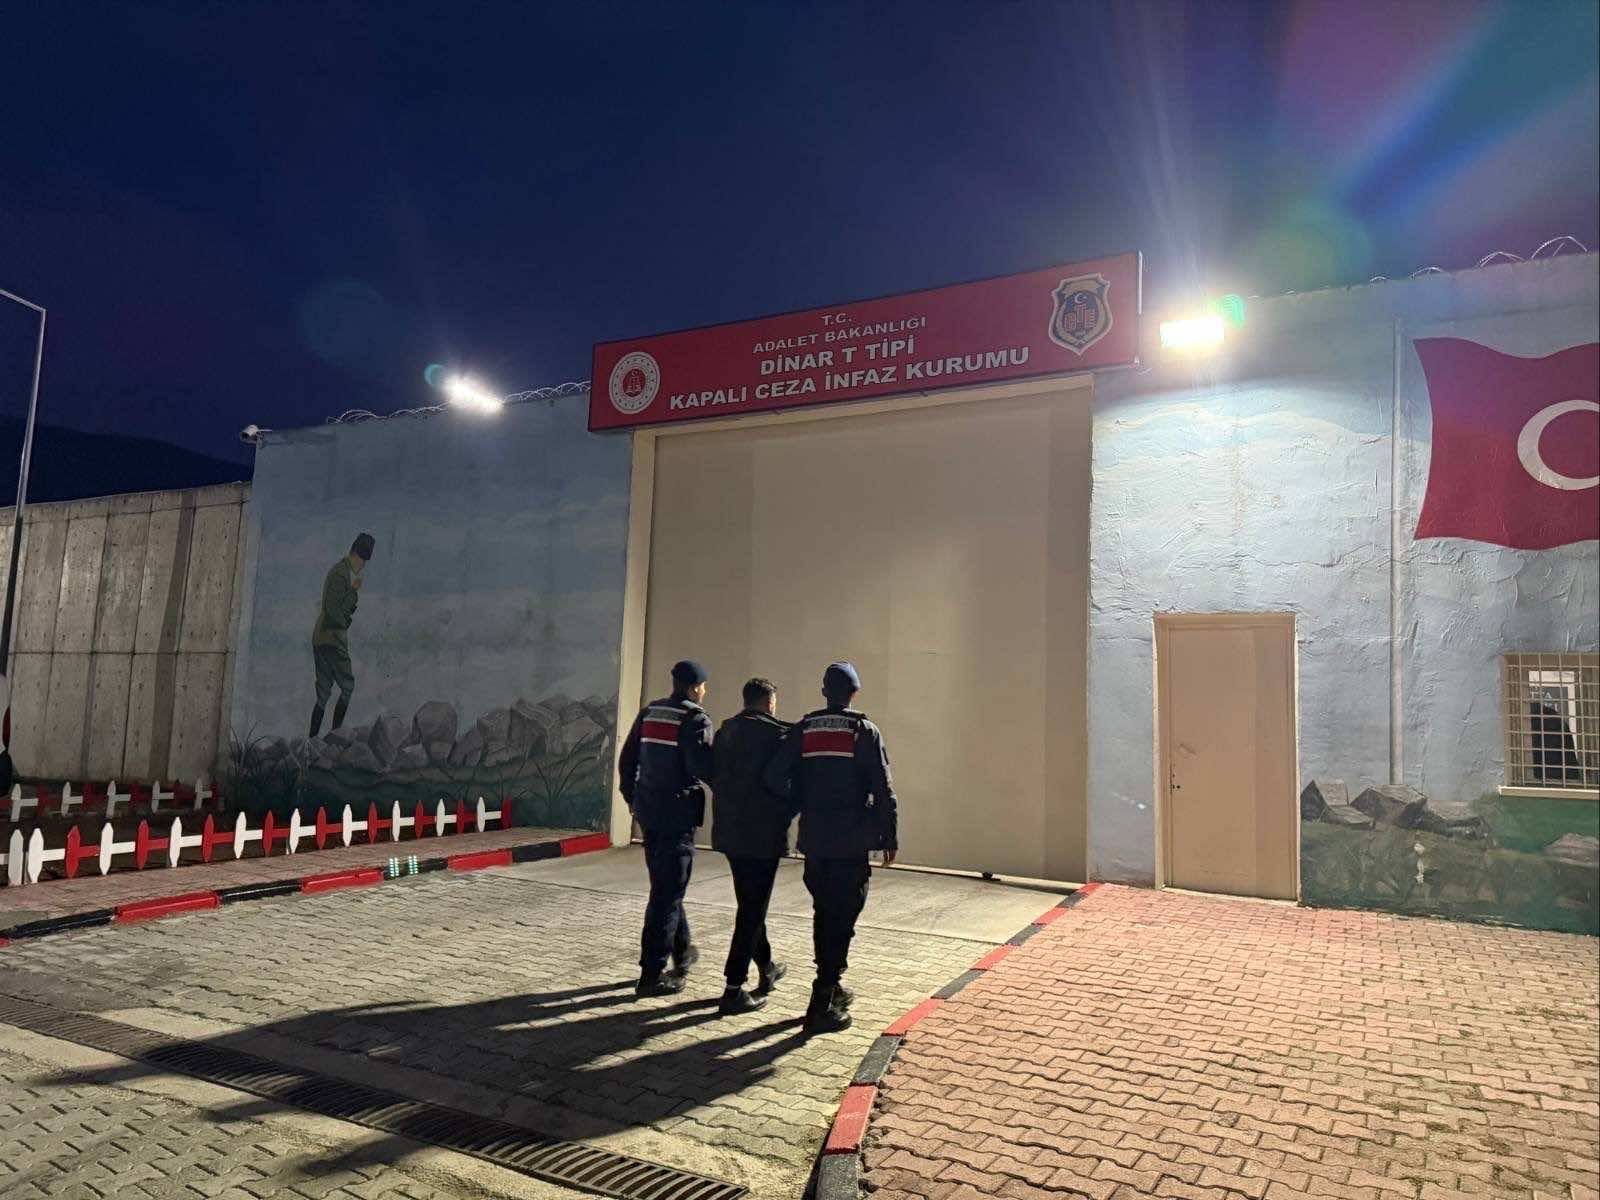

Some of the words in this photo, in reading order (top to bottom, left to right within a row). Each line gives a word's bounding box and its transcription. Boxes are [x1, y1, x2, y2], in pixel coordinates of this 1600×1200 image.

[822, 312, 852, 326] T.C.
[752, 333, 819, 354] ADALET
[760, 354, 834, 376] DİNAR
[842, 347, 857, 363] T
[865, 334, 914, 360] TİPİ
[670, 386, 748, 411] KAPALI
[755, 378, 817, 400] CEZA
[825, 367, 897, 391] İNFAZ
[906, 346, 1030, 380] KURUMU
